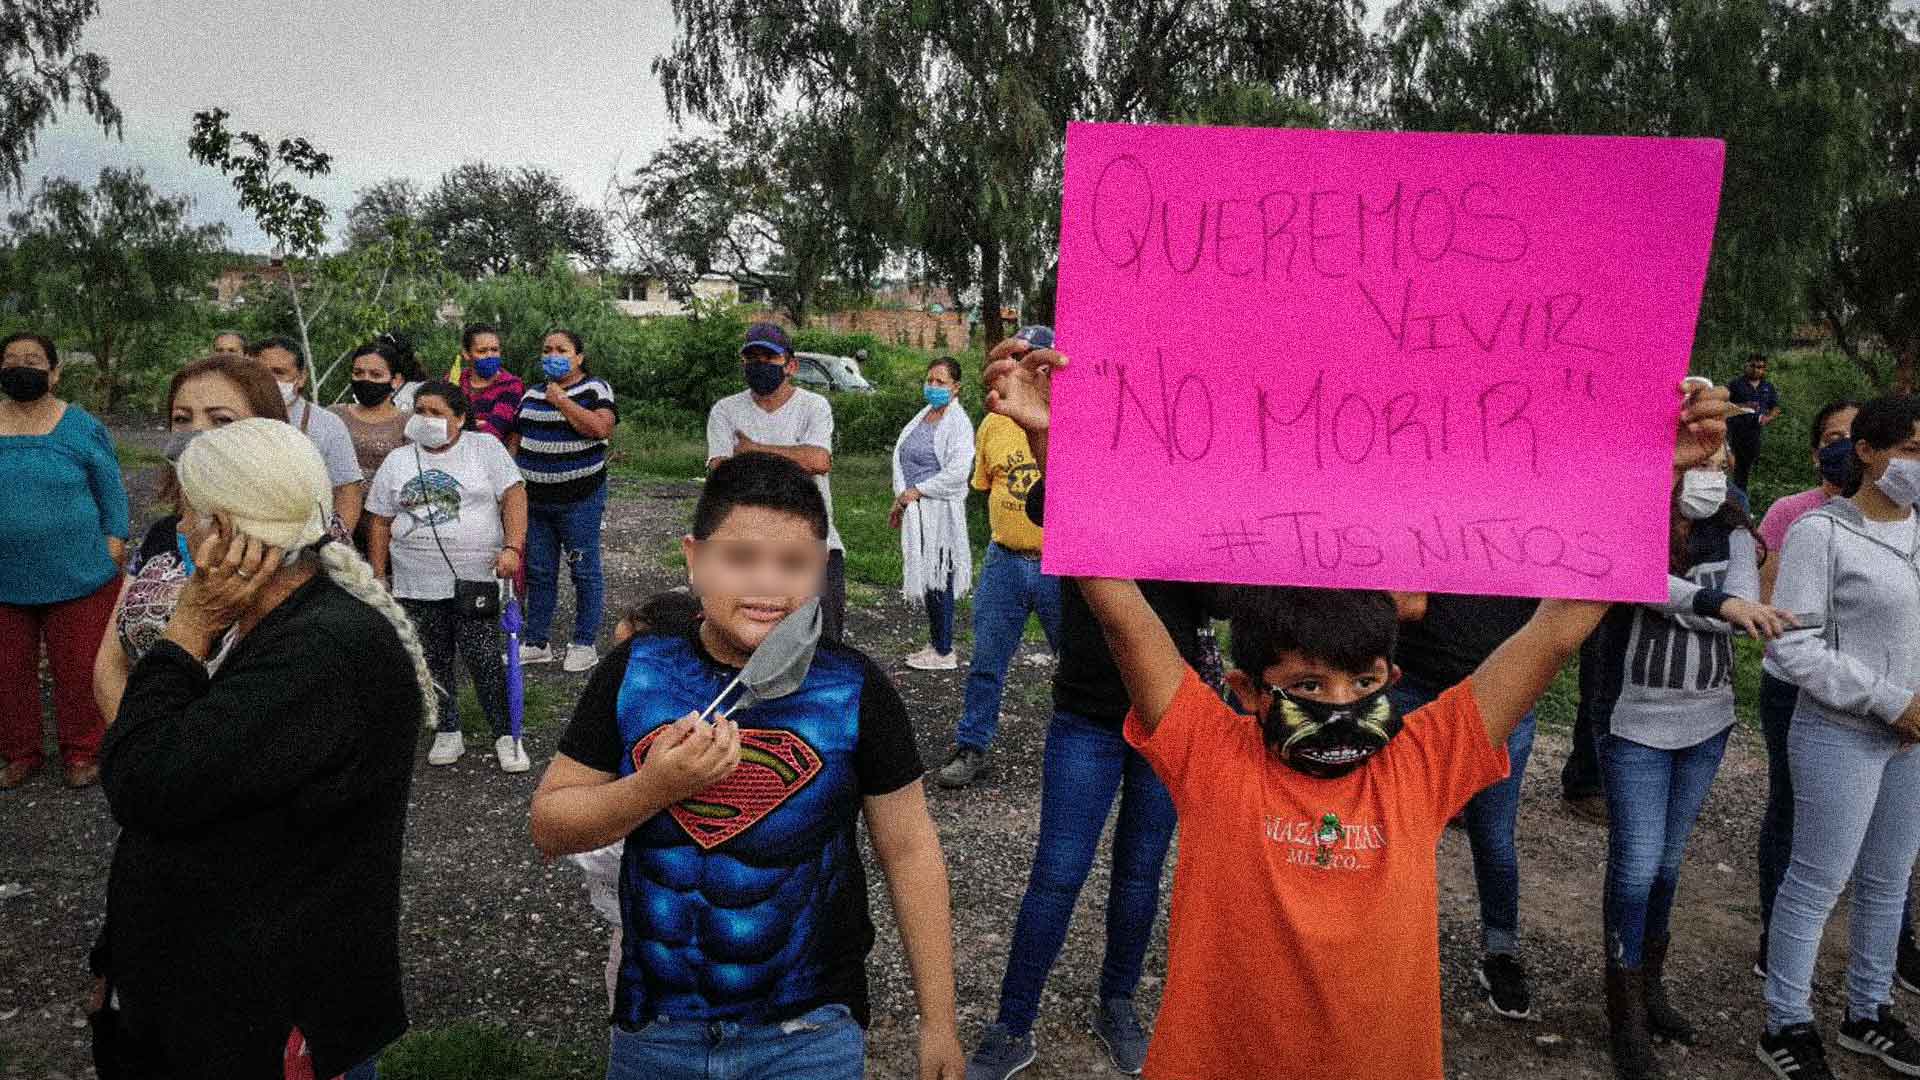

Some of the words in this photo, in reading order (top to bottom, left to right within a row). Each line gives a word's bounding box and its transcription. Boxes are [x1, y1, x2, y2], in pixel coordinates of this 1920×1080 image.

[1091, 153, 1529, 281] QUEREMOS
[1358, 278, 1613, 354] VIVIR
[1264, 814, 1388, 851] MAZTLAN
